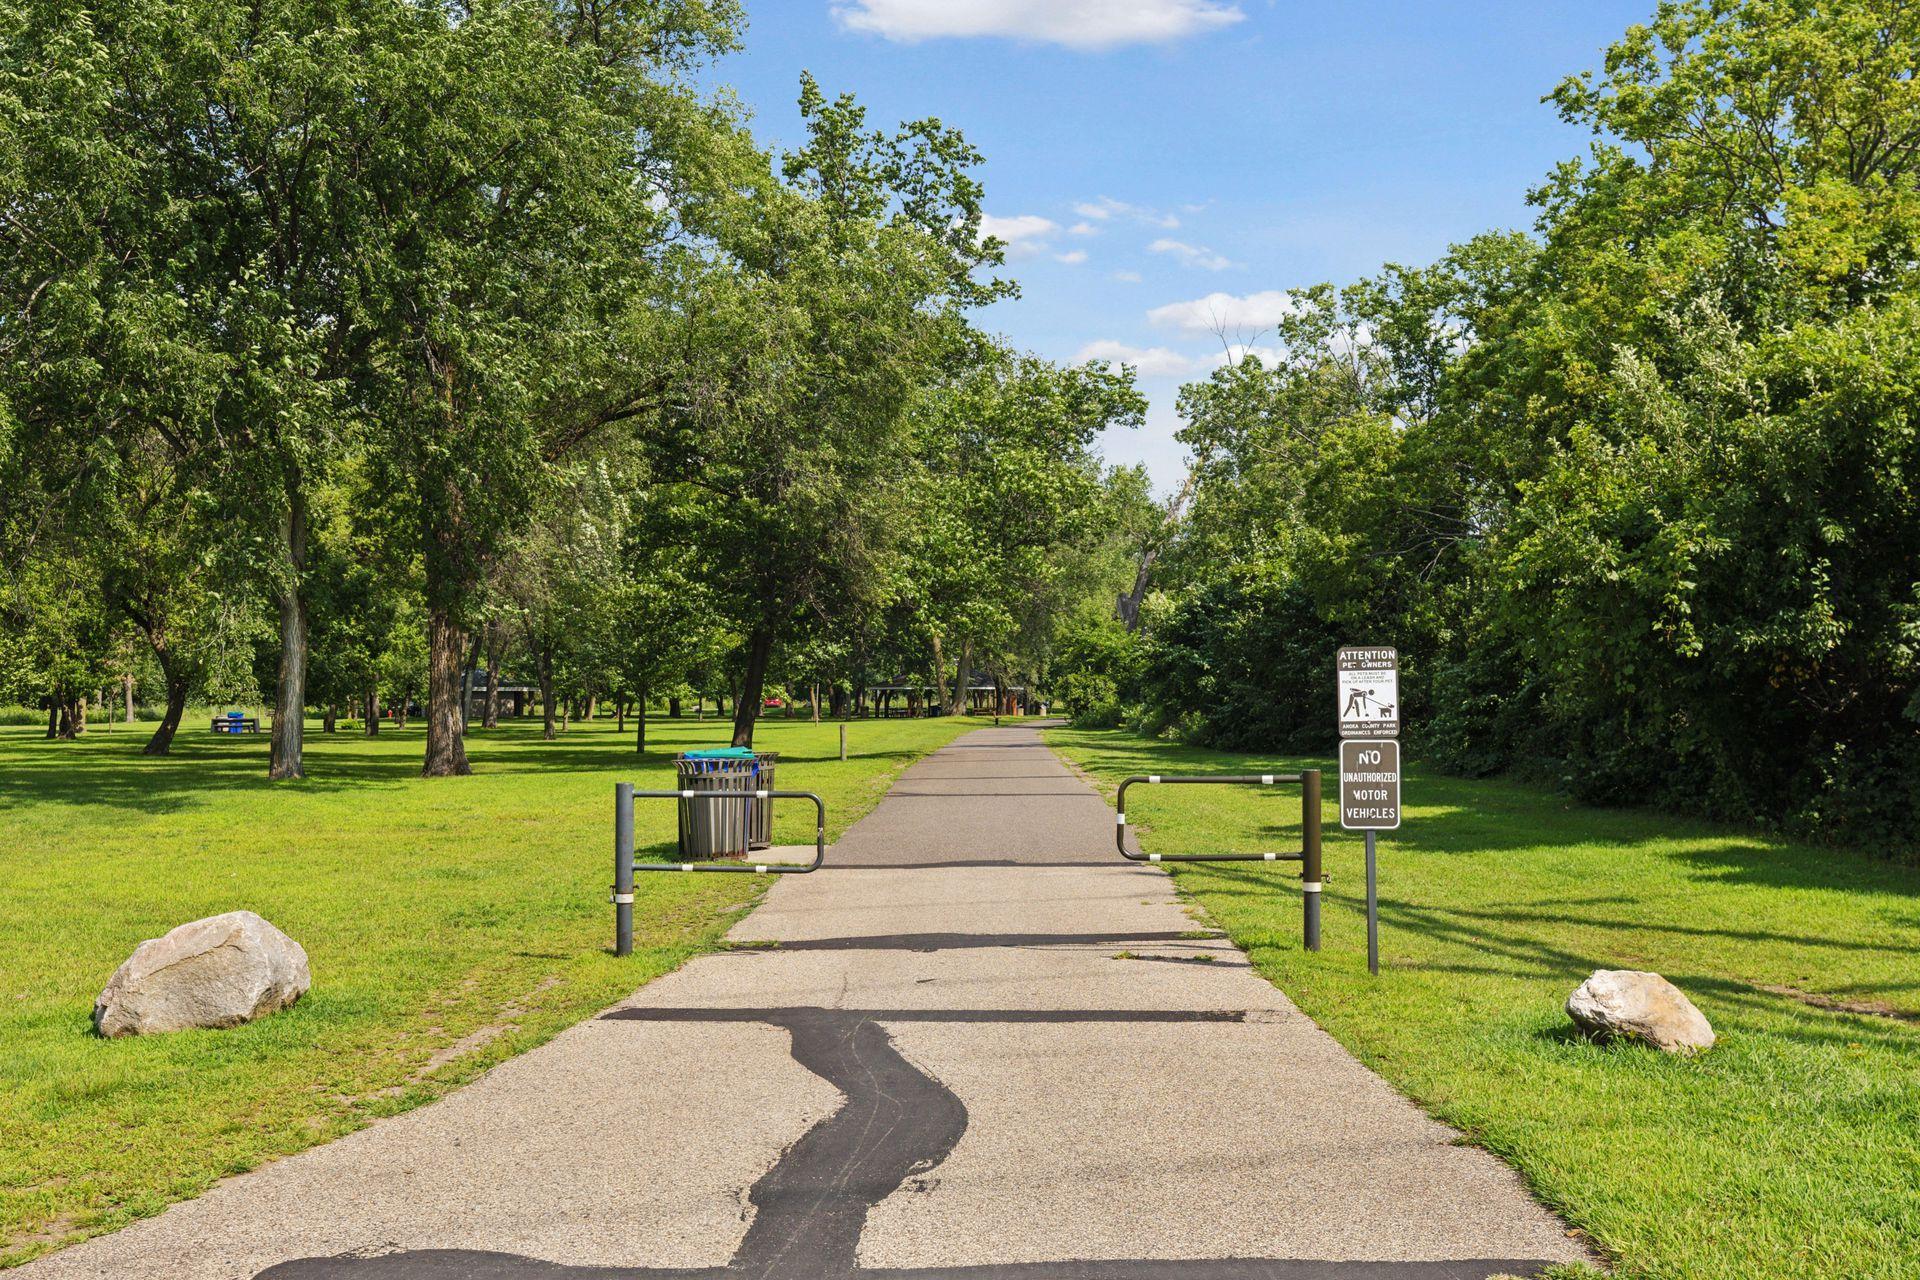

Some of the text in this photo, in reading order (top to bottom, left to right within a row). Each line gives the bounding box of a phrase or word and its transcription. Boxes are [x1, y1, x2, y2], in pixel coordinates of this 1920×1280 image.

[1340, 651, 1395, 660] ATTENTION
[1359, 750, 1380, 764] NO
[1344, 773, 1396, 782] UNAUTHORIZED
[1353, 790, 1388, 800] MOTOR
[1347, 808, 1394, 818] VEHICLES
